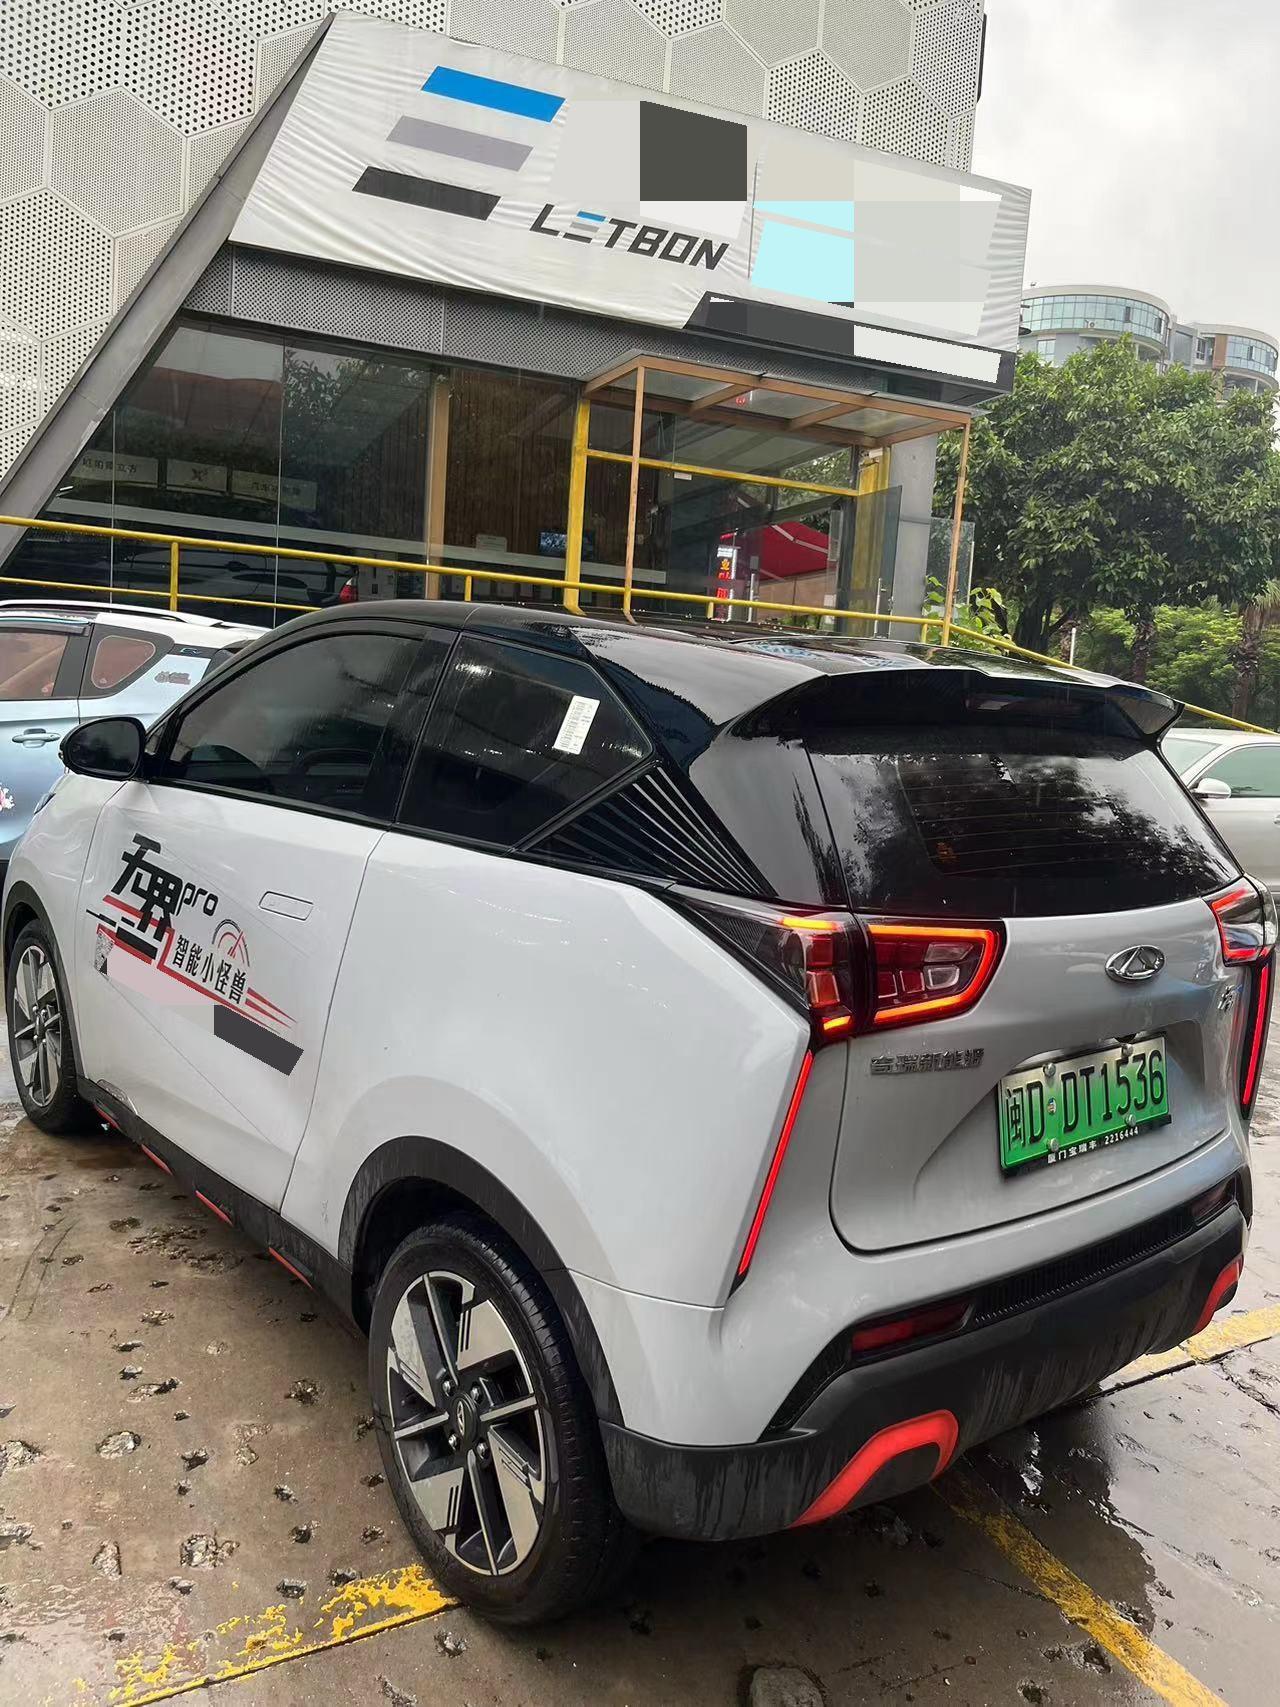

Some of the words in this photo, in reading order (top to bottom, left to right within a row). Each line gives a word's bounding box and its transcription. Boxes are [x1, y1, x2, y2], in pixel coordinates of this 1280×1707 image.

[529, 203, 730, 271] LETBON
[172, 934, 247, 1005] 智能小怪兽
[1104, 1126, 1139, 1145] 2216444
